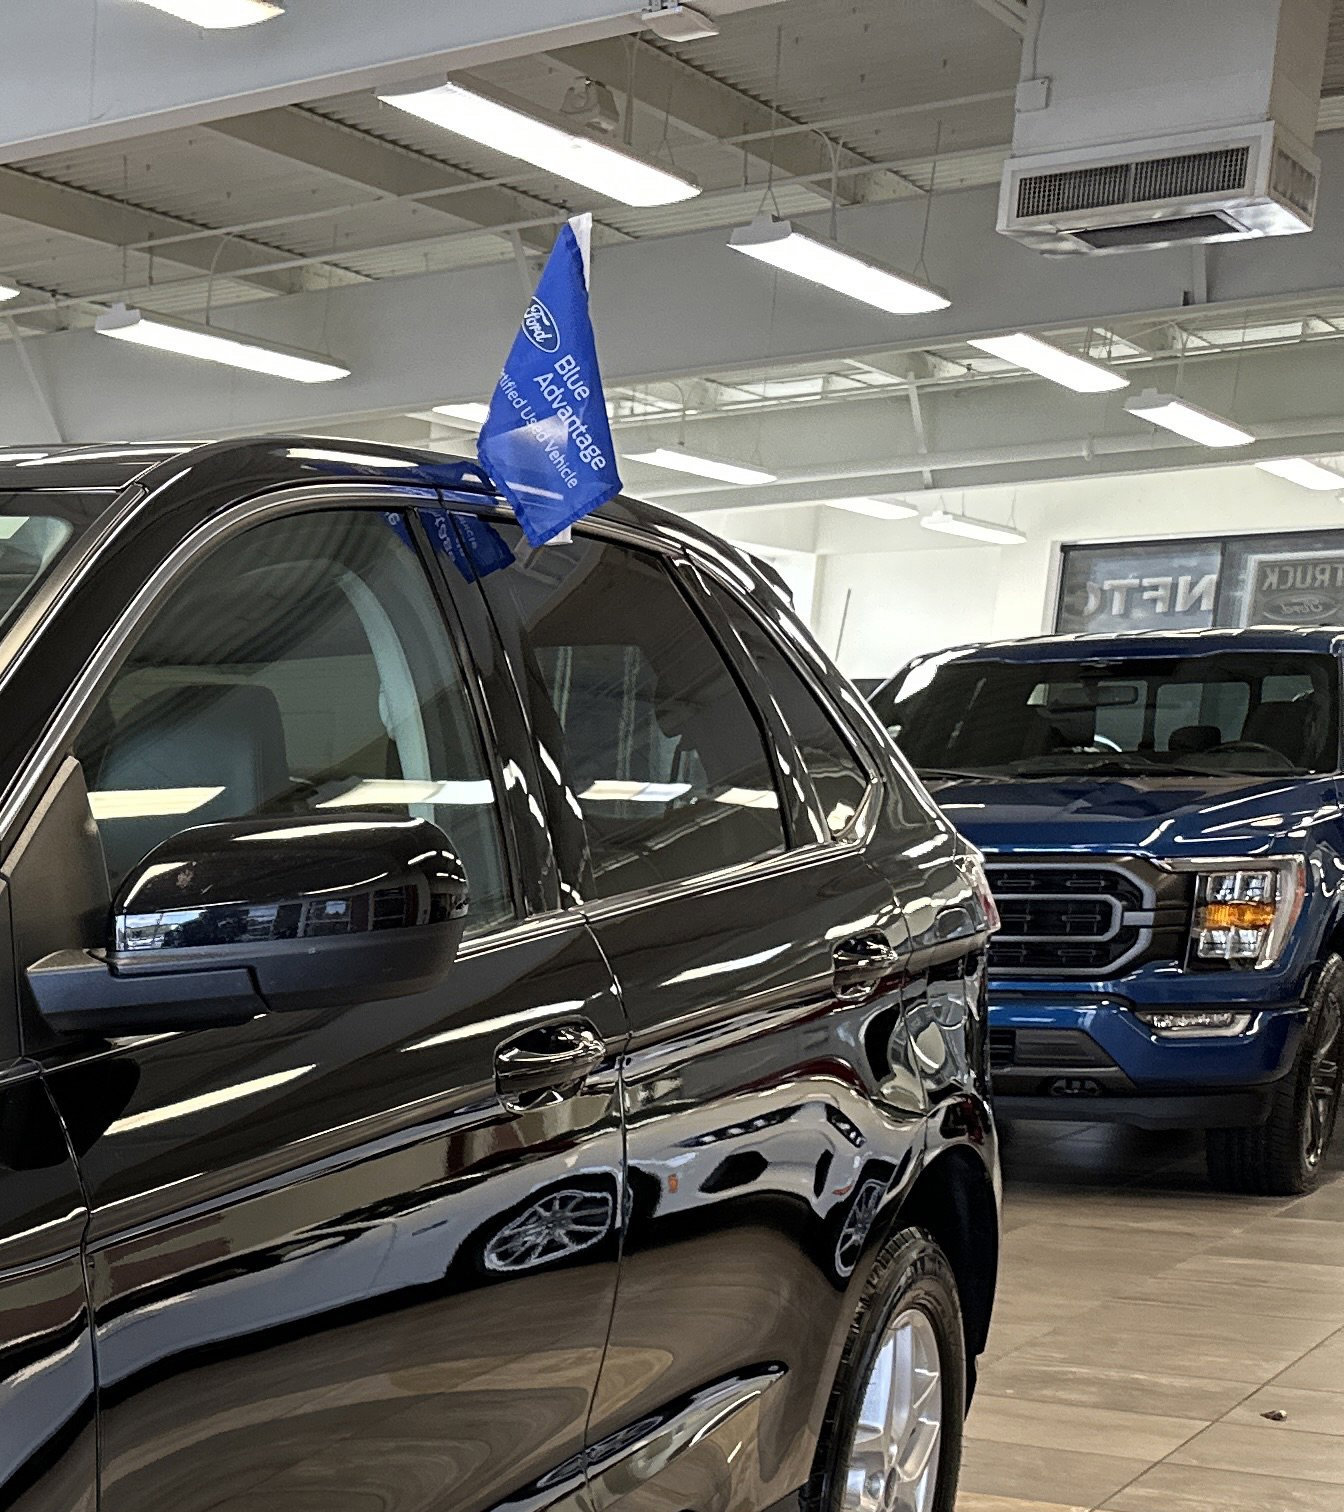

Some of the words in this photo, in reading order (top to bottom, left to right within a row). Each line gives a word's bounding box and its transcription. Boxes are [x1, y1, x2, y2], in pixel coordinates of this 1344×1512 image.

[523, 303, 553, 344] Ford
[554, 354, 591, 402] Blue
[520, 405, 551, 444] Used
[543, 440, 578, 490] Vehicle
[533, 372, 607, 472] Advantage
